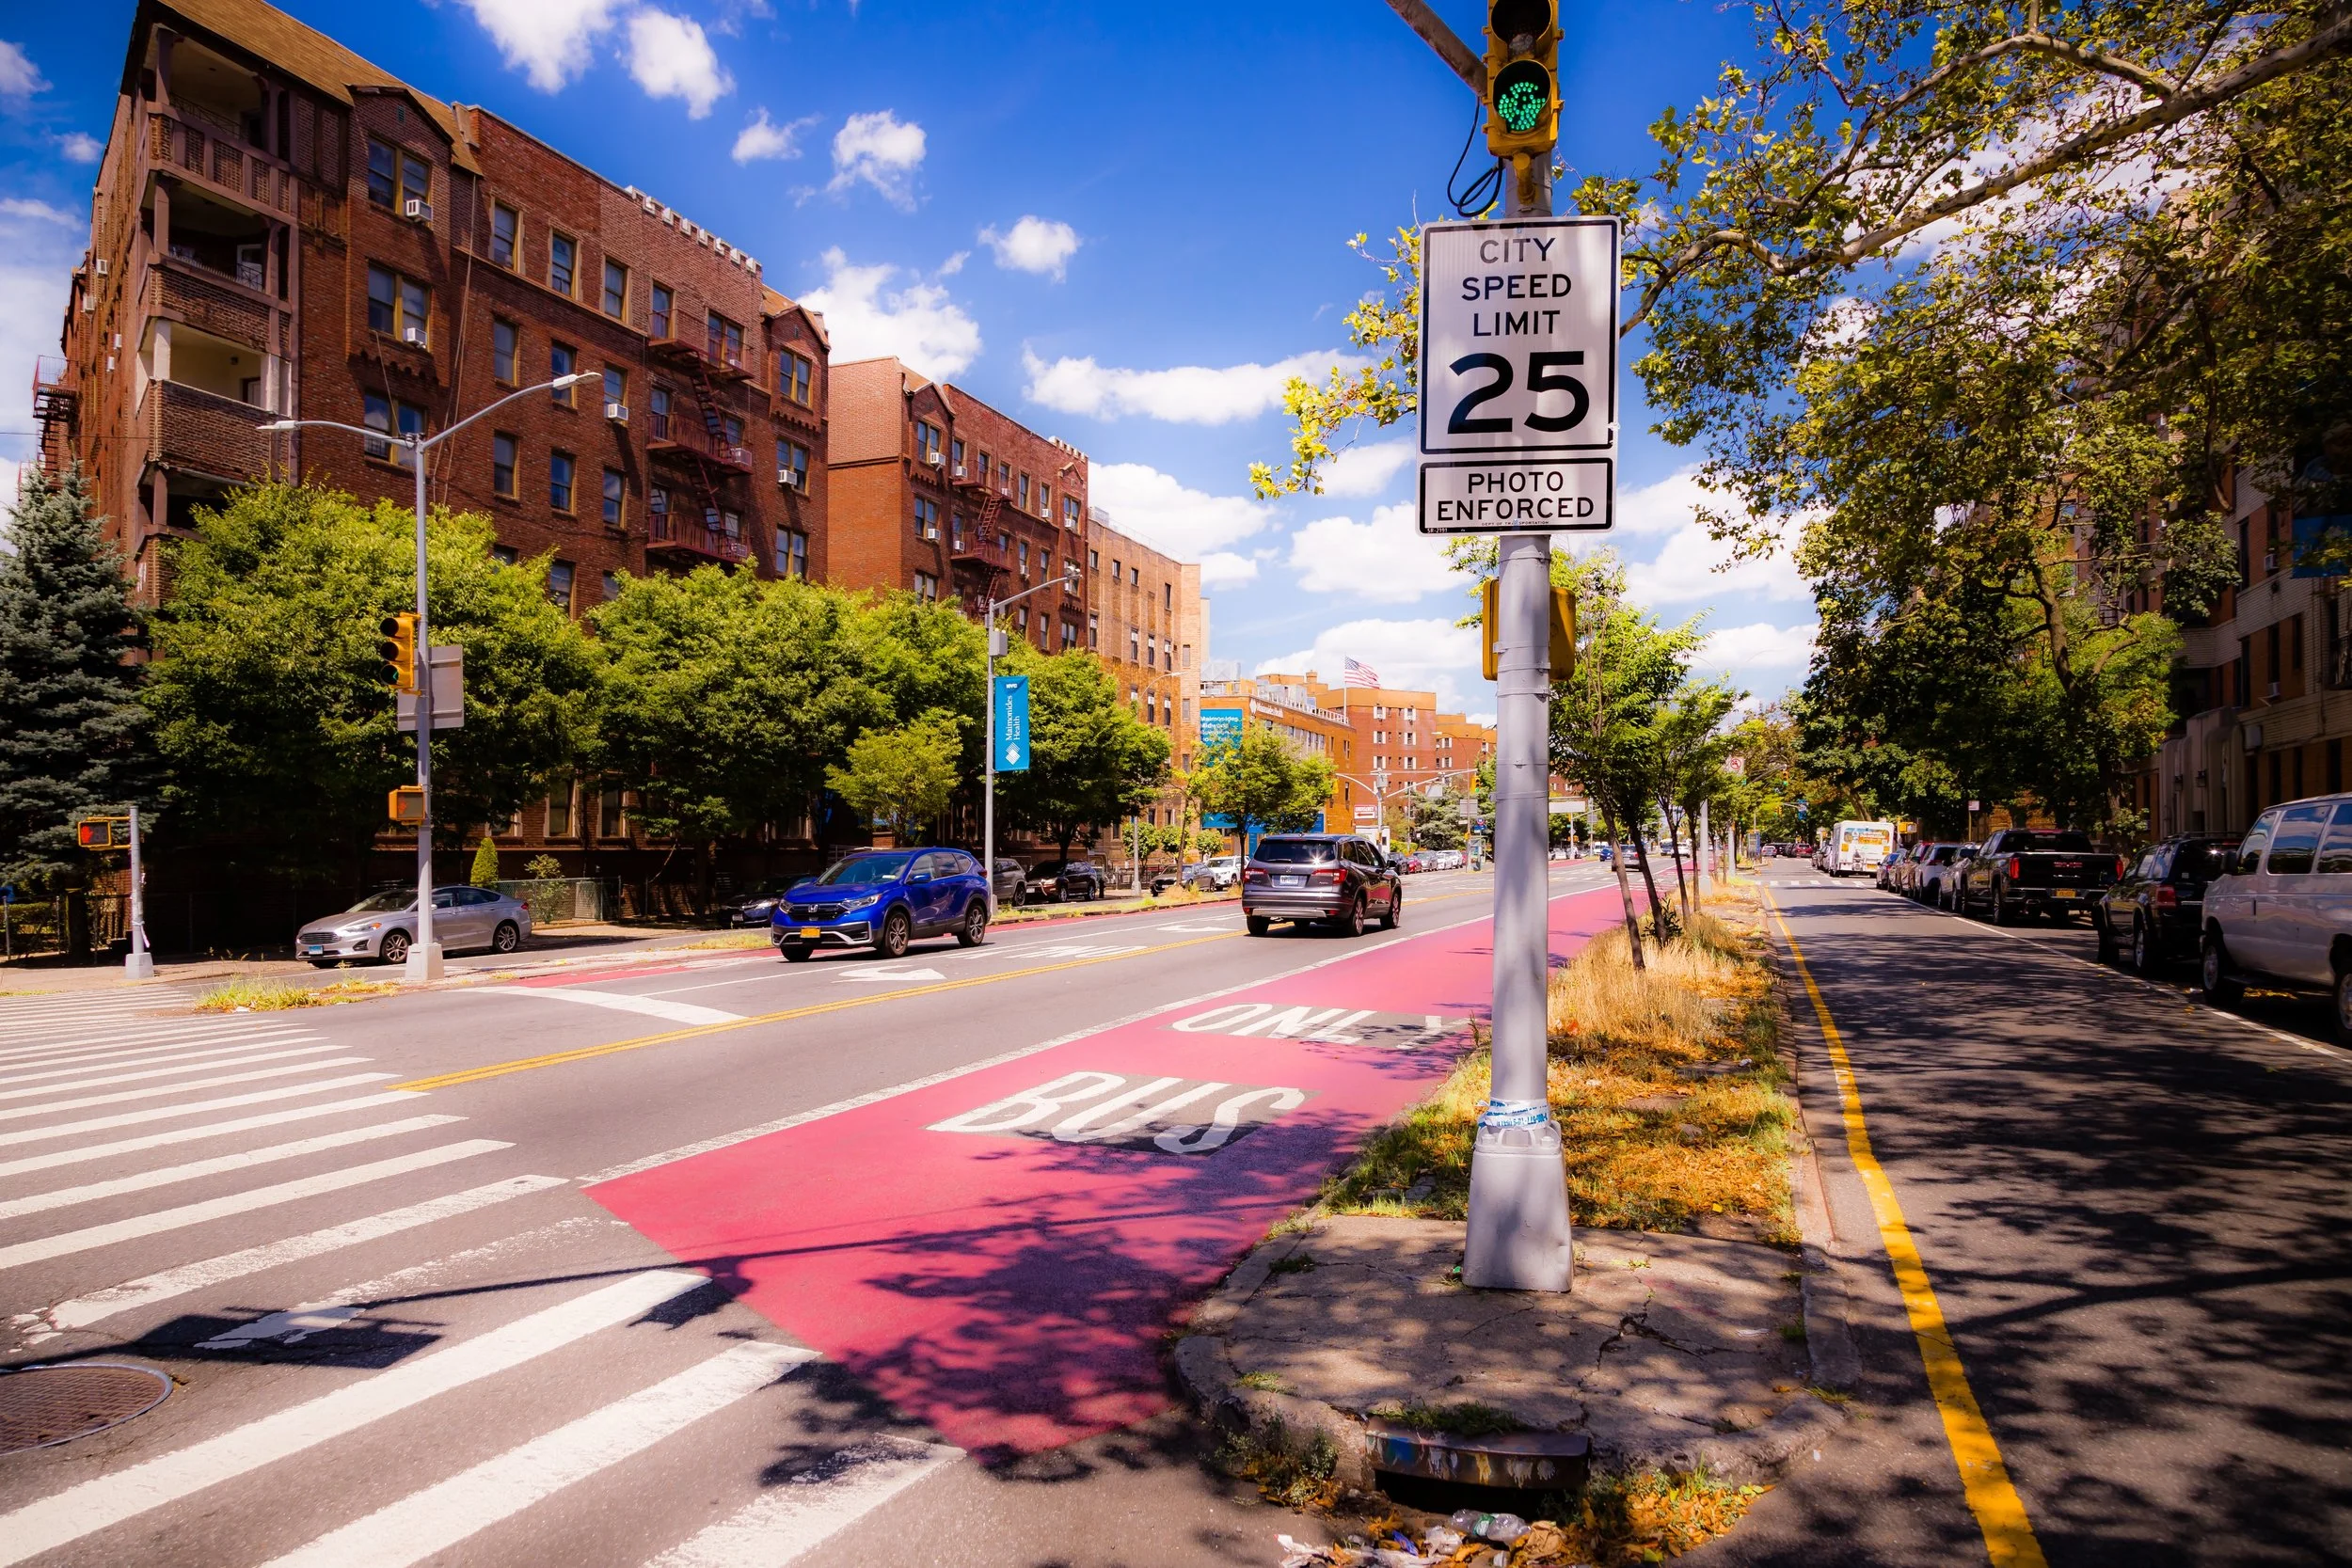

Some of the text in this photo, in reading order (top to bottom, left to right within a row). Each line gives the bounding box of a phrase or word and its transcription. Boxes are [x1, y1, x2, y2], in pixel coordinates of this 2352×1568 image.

[1480, 237, 1555, 263] CITY
[1461, 274, 1572, 301] SPEED
[1472, 309, 1561, 337] LIMIT
[1447, 350, 1590, 435] 25
[1468, 471, 1564, 494] PHOTO
[1437, 497, 1594, 521] ENFORCED
[1172, 1004, 1474, 1049] ONLY
[926, 1071, 1306, 1154] BUS
